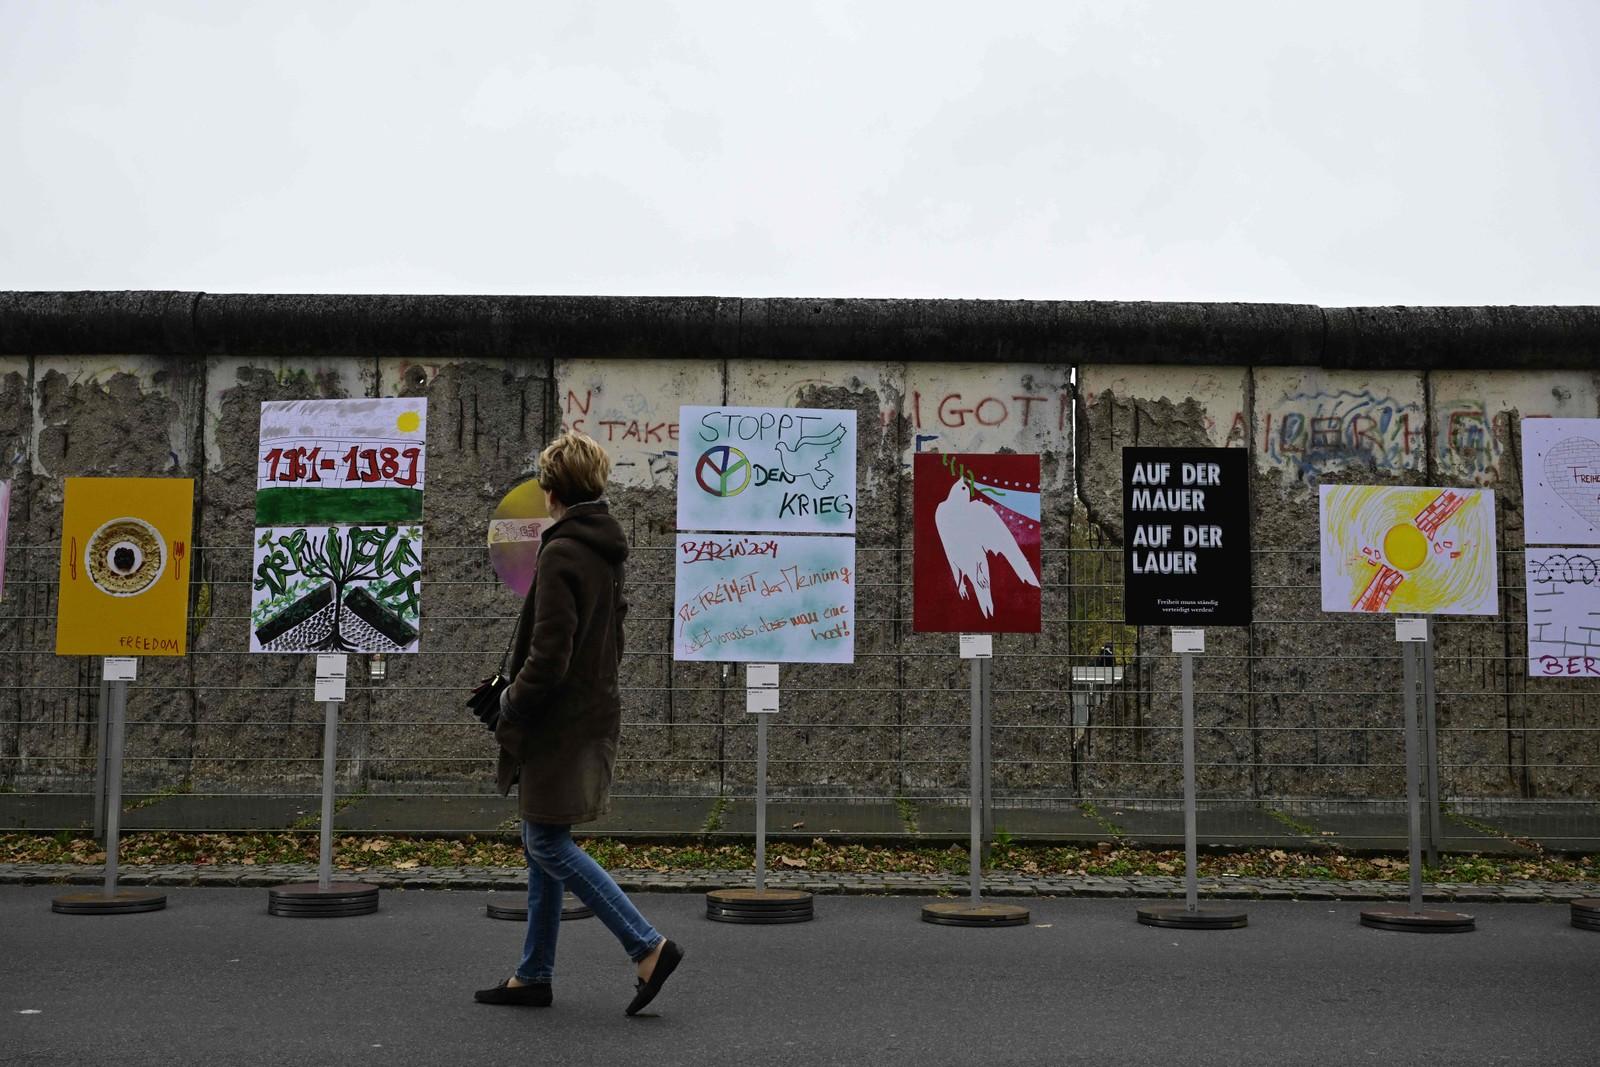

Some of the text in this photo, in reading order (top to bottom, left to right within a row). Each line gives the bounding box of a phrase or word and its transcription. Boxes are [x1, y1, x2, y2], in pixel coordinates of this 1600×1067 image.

[938, 393, 1049, 427] GOT
[699, 411, 822, 442] STOPPT
[752, 463, 796, 487] DEN
[1131, 461, 1221, 486] AUF DER
[778, 492, 853, 519] KRIEG
[1131, 488, 1205, 512] MAUER
[1132, 524, 1223, 548] AUF DER
[1132, 550, 1198, 575] LAUER
[119, 635, 180, 654] FREEDOM
